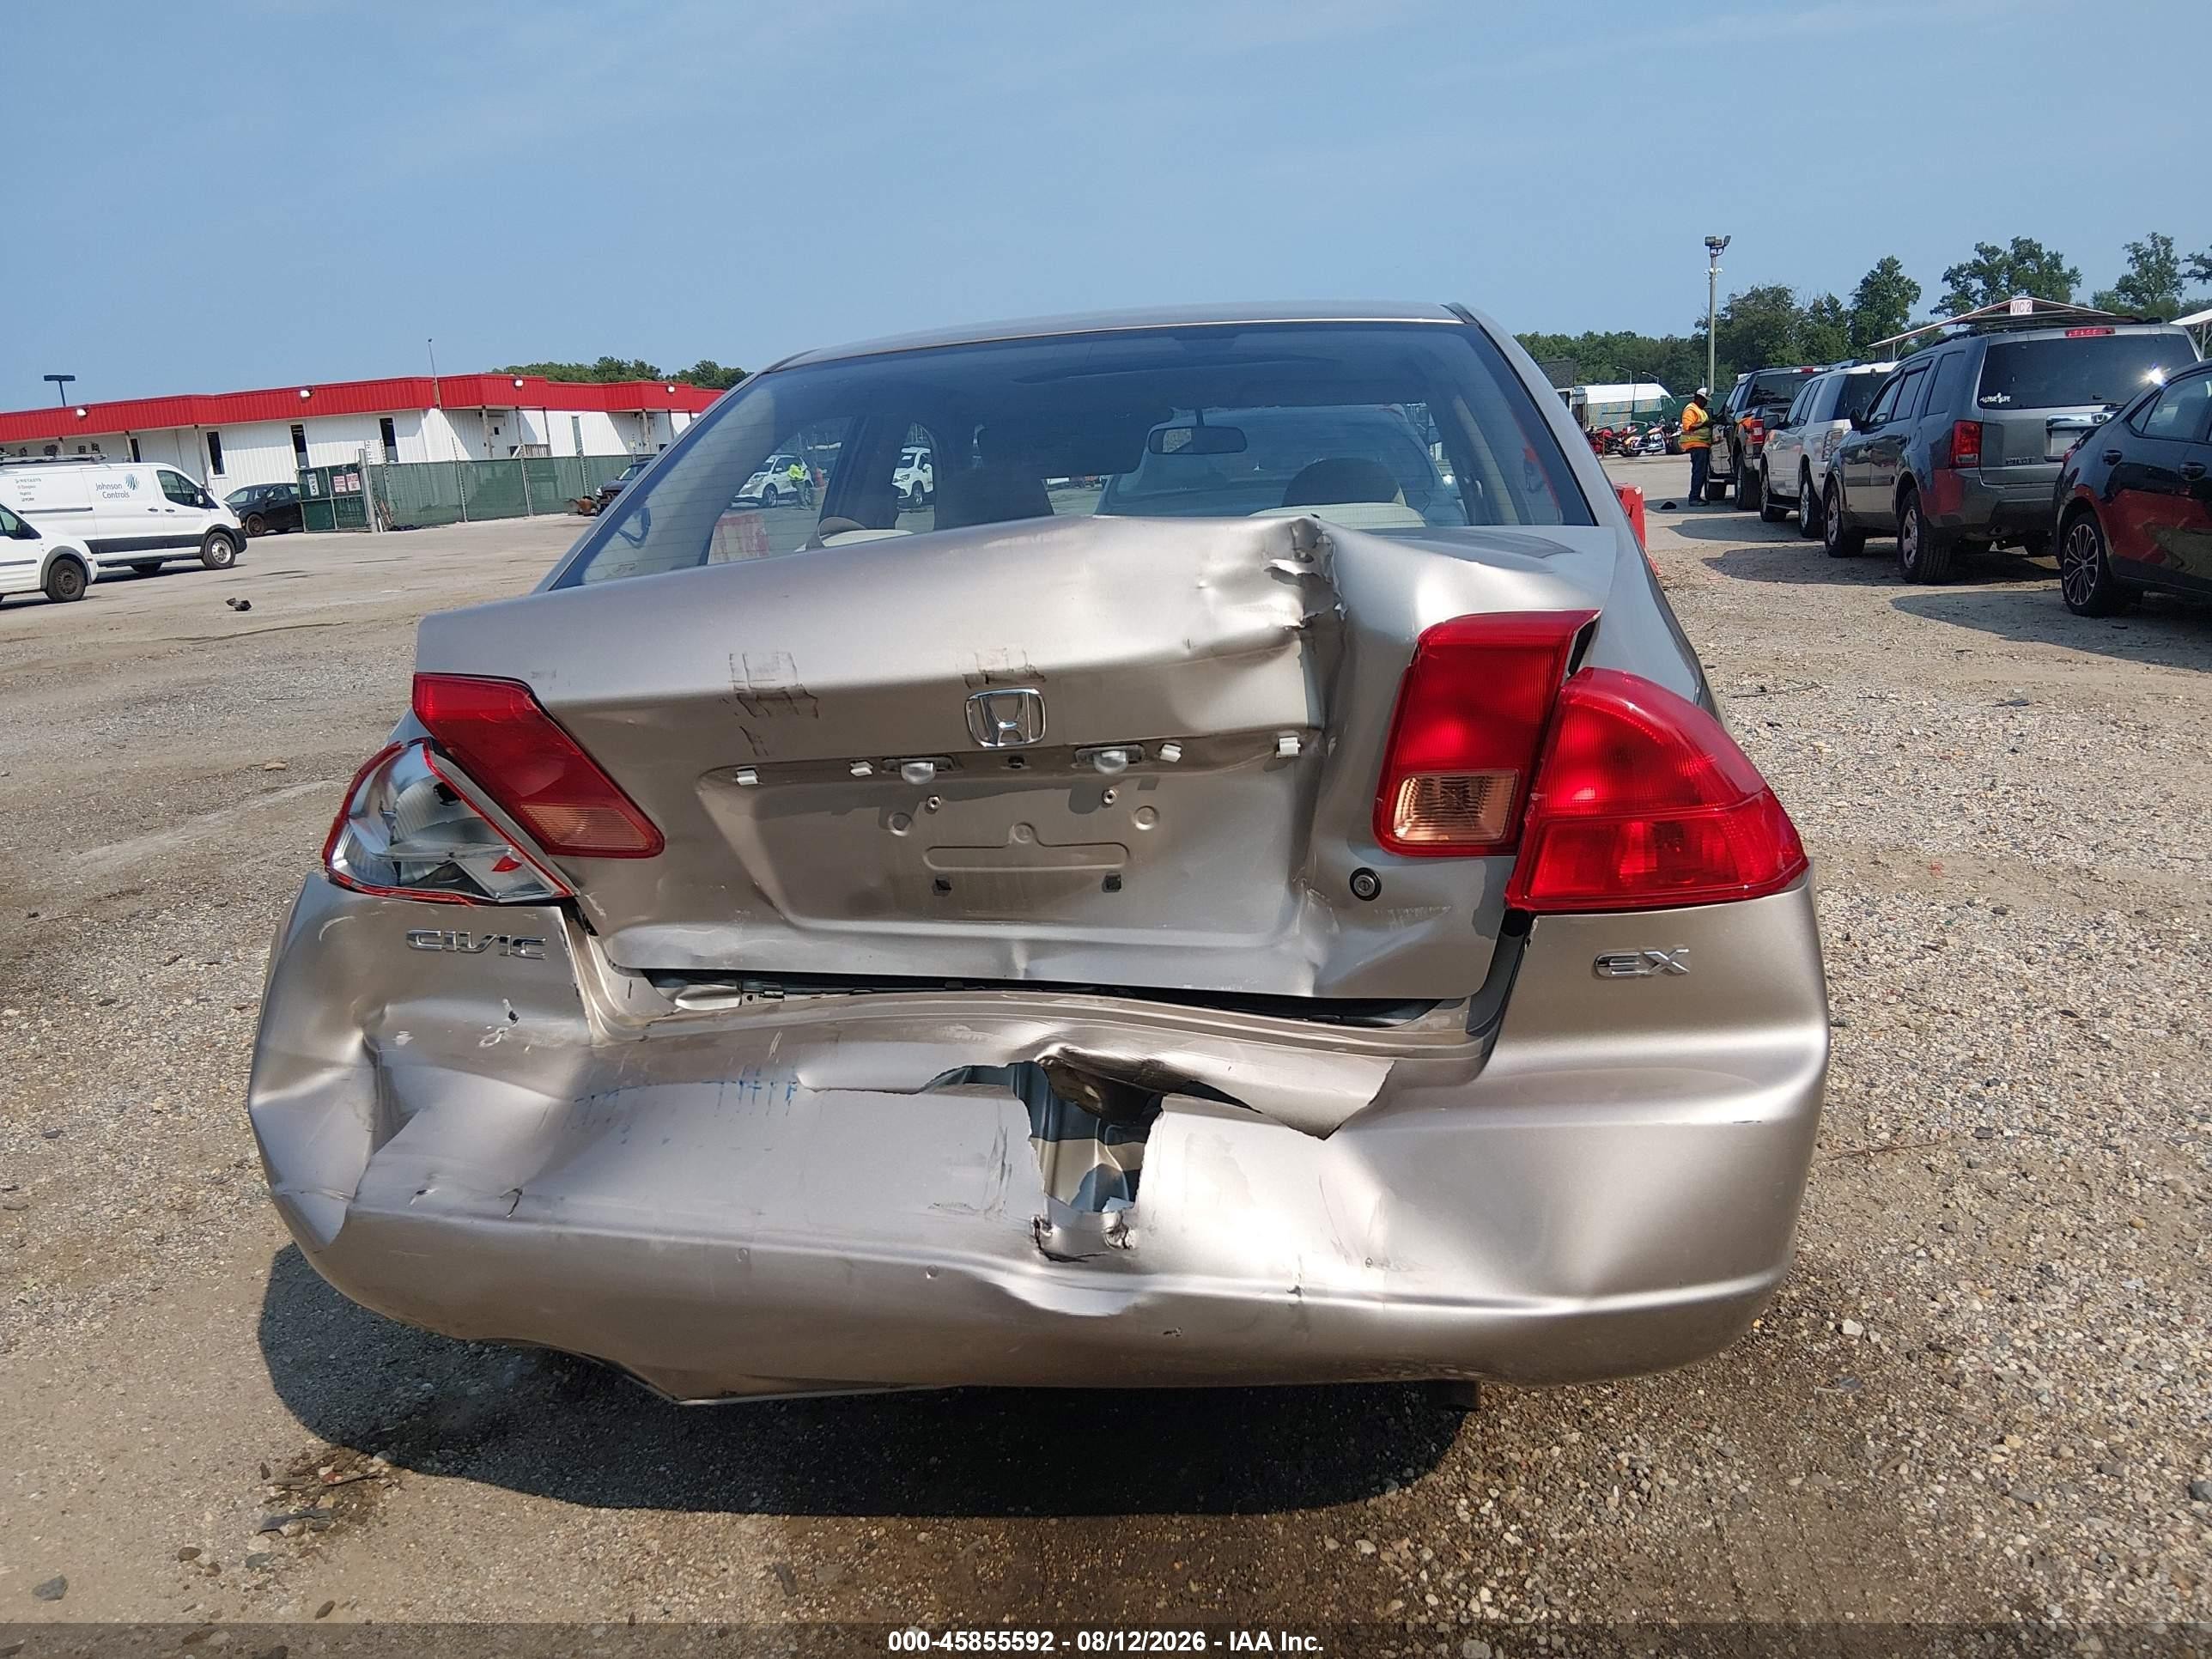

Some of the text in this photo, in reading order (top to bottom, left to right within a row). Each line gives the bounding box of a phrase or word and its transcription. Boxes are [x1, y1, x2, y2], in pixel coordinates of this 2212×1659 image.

[2012, 301, 2032, 313] VIC 2
[2005, 456, 2035, 466] PILOT
[95, 482, 123, 490] Johnson
[102, 489, 130, 499] Controls
[406, 929, 547, 960] CIVIC
[1594, 948, 1690, 977] EX
